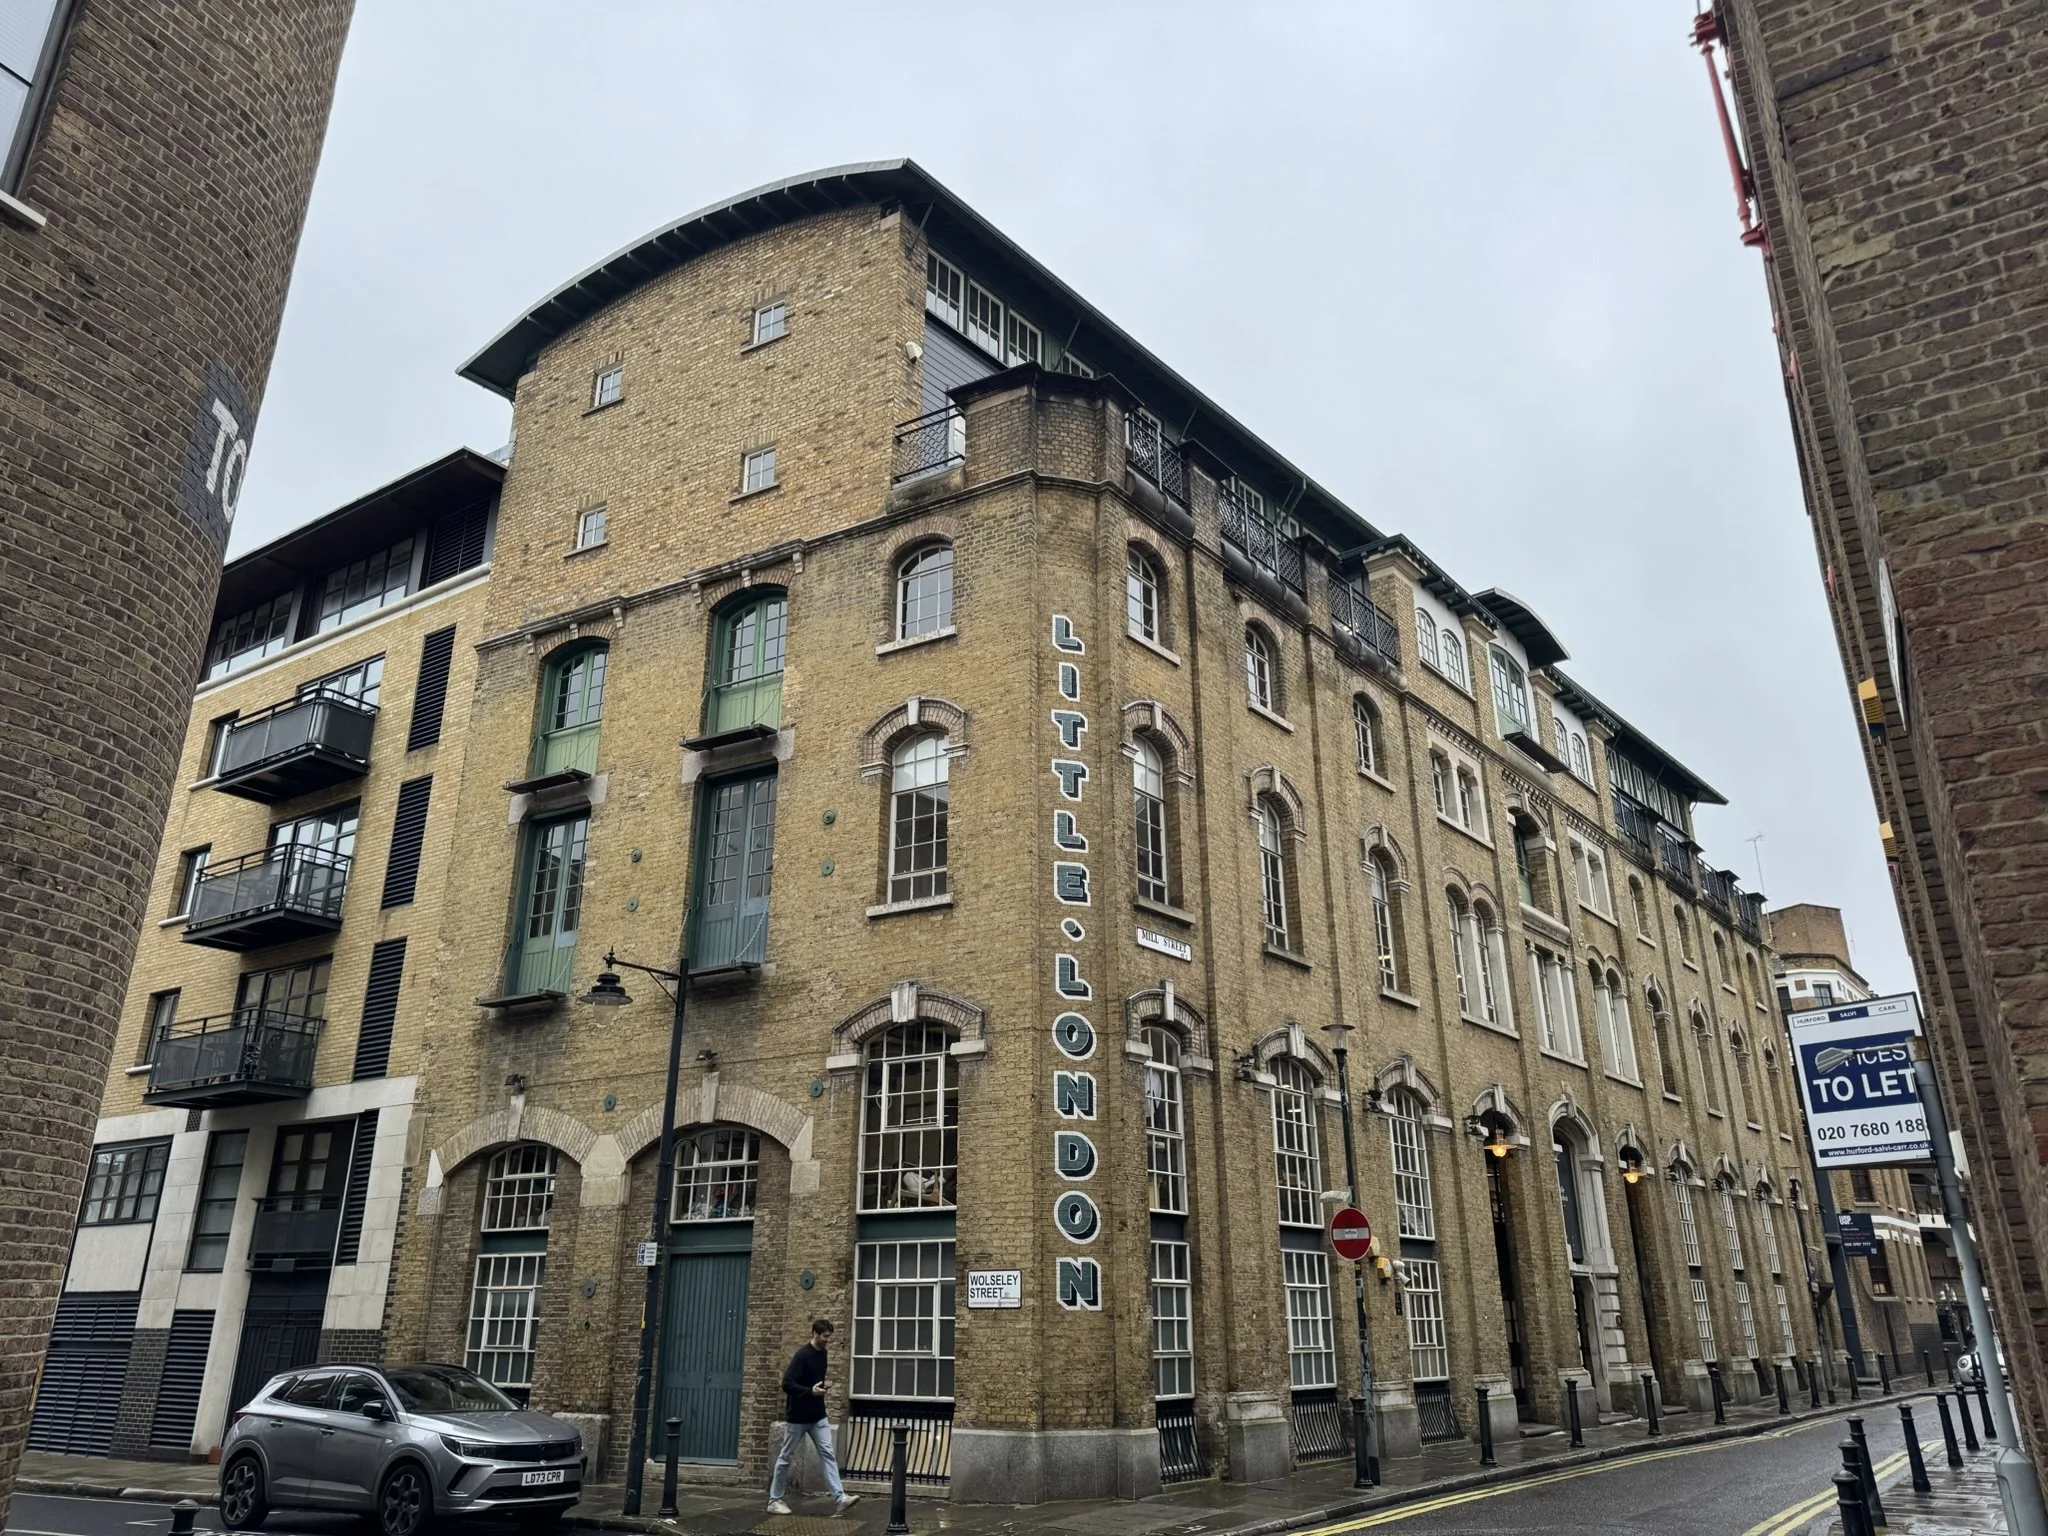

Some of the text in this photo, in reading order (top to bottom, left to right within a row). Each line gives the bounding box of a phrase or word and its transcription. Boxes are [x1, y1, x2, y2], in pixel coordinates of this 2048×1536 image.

[1141, 930, 1187, 953] MILL STREET
[1797, 1004, 1896, 1024] HURFORD SALVI CARR
[1812, 1067, 1916, 1102] TO LET
[1817, 1126, 1846, 1141] 020
[1850, 1121, 1890, 1138] 7680
[970, 1274, 1019, 1286] WOLSELEY
[969, 1287, 1004, 1299] STREET
[546, 1471, 562, 1482] CPR
